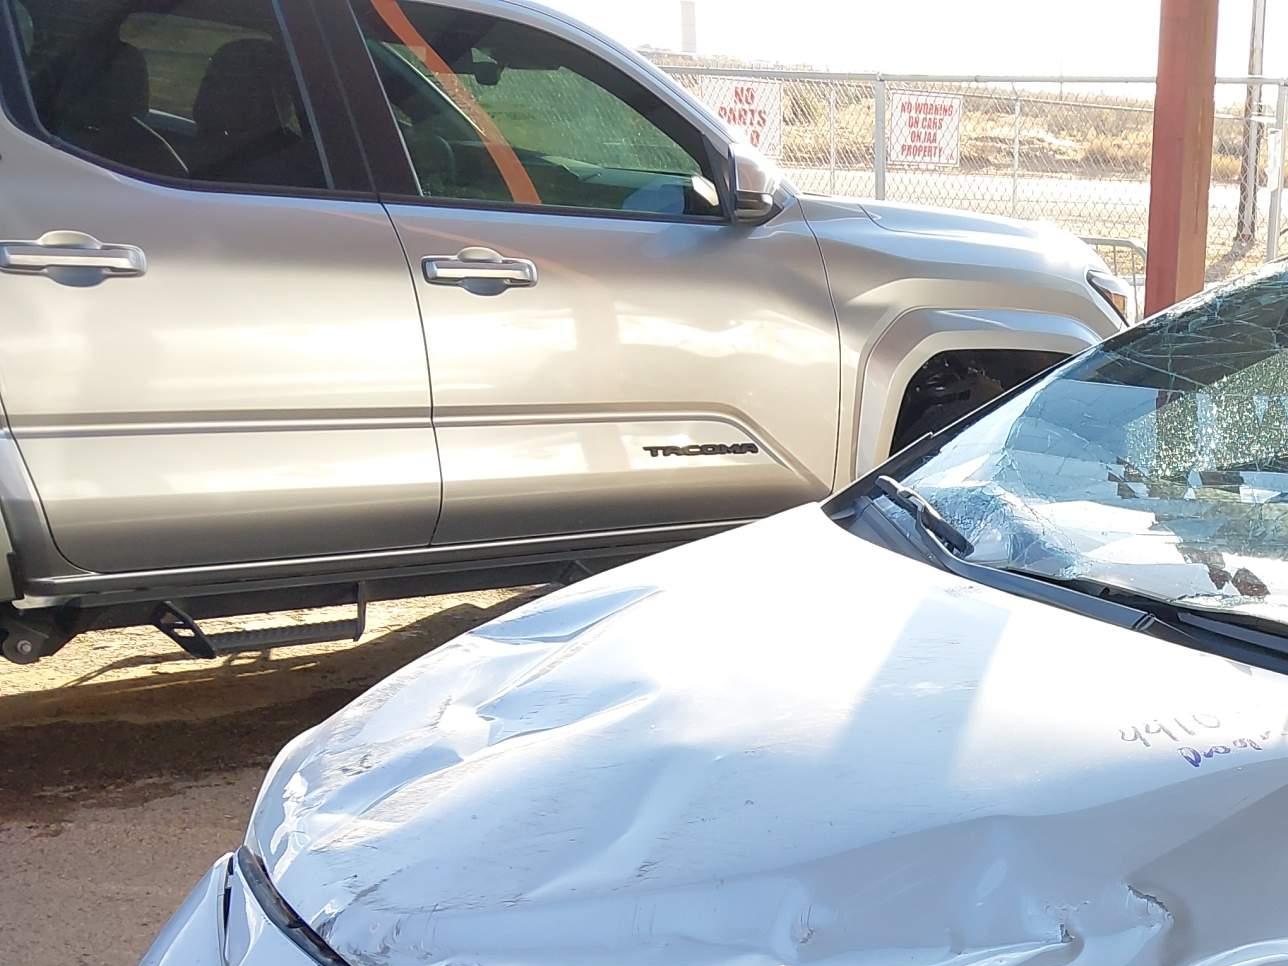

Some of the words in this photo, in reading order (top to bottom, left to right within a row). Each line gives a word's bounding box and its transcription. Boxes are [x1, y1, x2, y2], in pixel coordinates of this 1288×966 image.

[734, 86, 755, 105] NO
[900, 101, 913, 114] NO
[914, 102, 954, 117] WORKING
[718, 106, 767, 128] PARTS
[908, 116, 920, 129] ON
[921, 117, 944, 130] CARS
[910, 130, 922, 143] ON
[923, 131, 937, 144] IAA
[900, 144, 944, 159] PROPERTY
[642, 443, 758, 457] TACOMA
